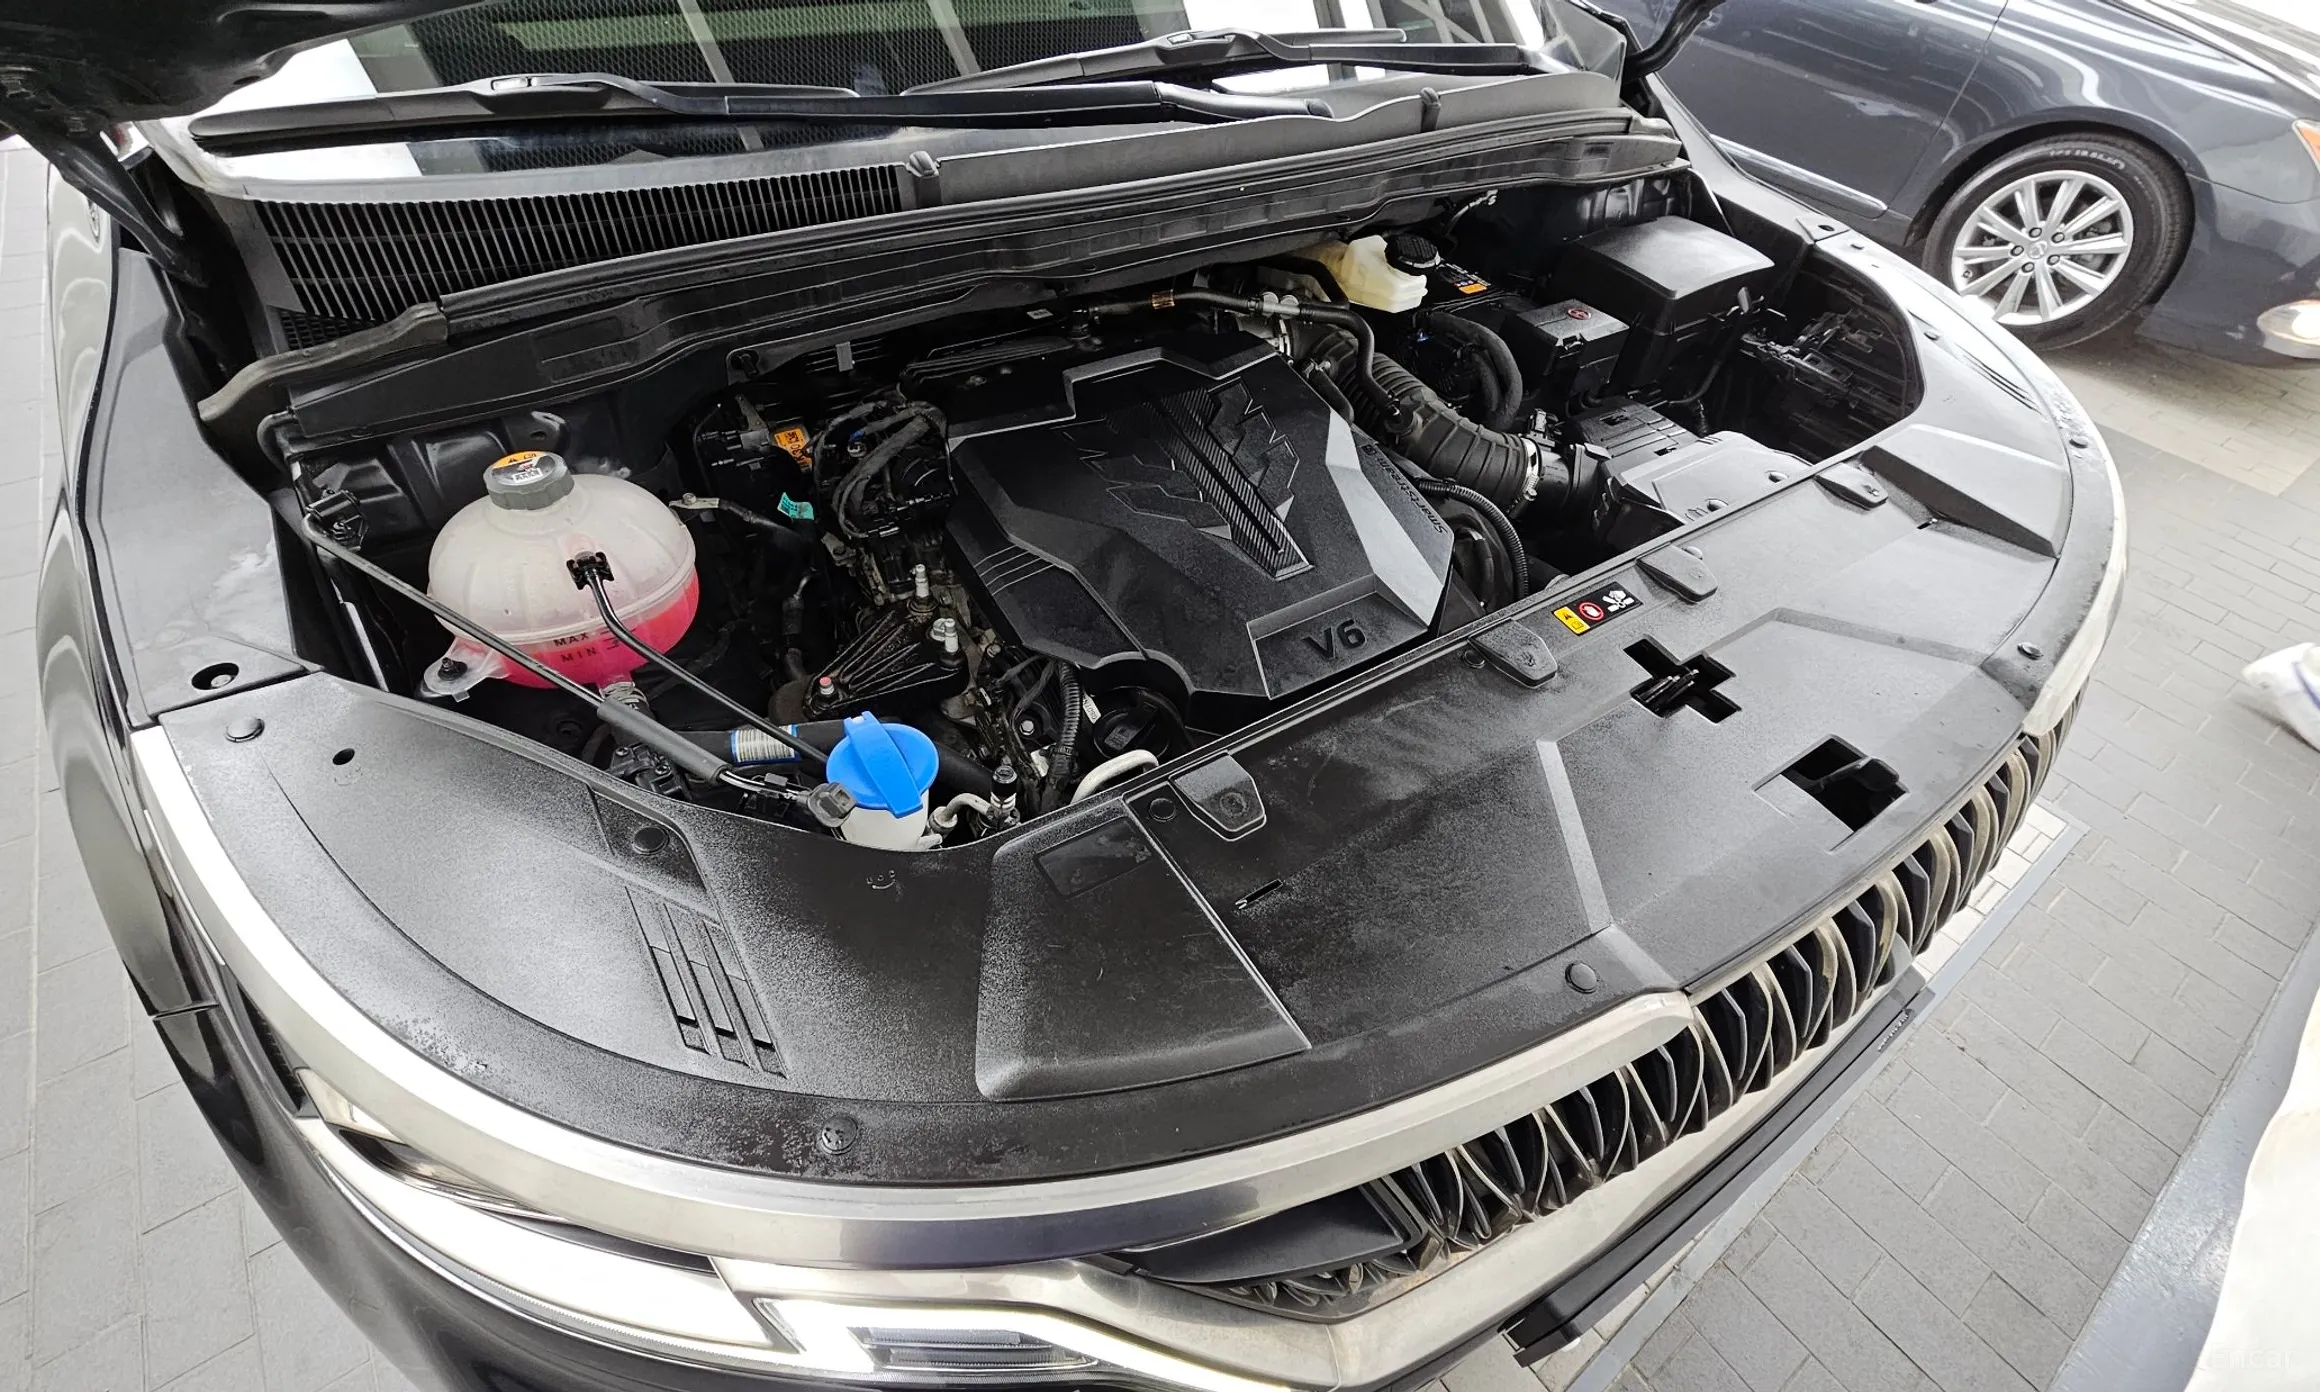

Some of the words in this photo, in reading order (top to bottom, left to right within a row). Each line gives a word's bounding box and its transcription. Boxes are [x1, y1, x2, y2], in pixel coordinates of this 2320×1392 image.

[553, 632, 589, 647] MAX
[1301, 618, 1367, 660] V6
[560, 647, 597, 662] MIN
